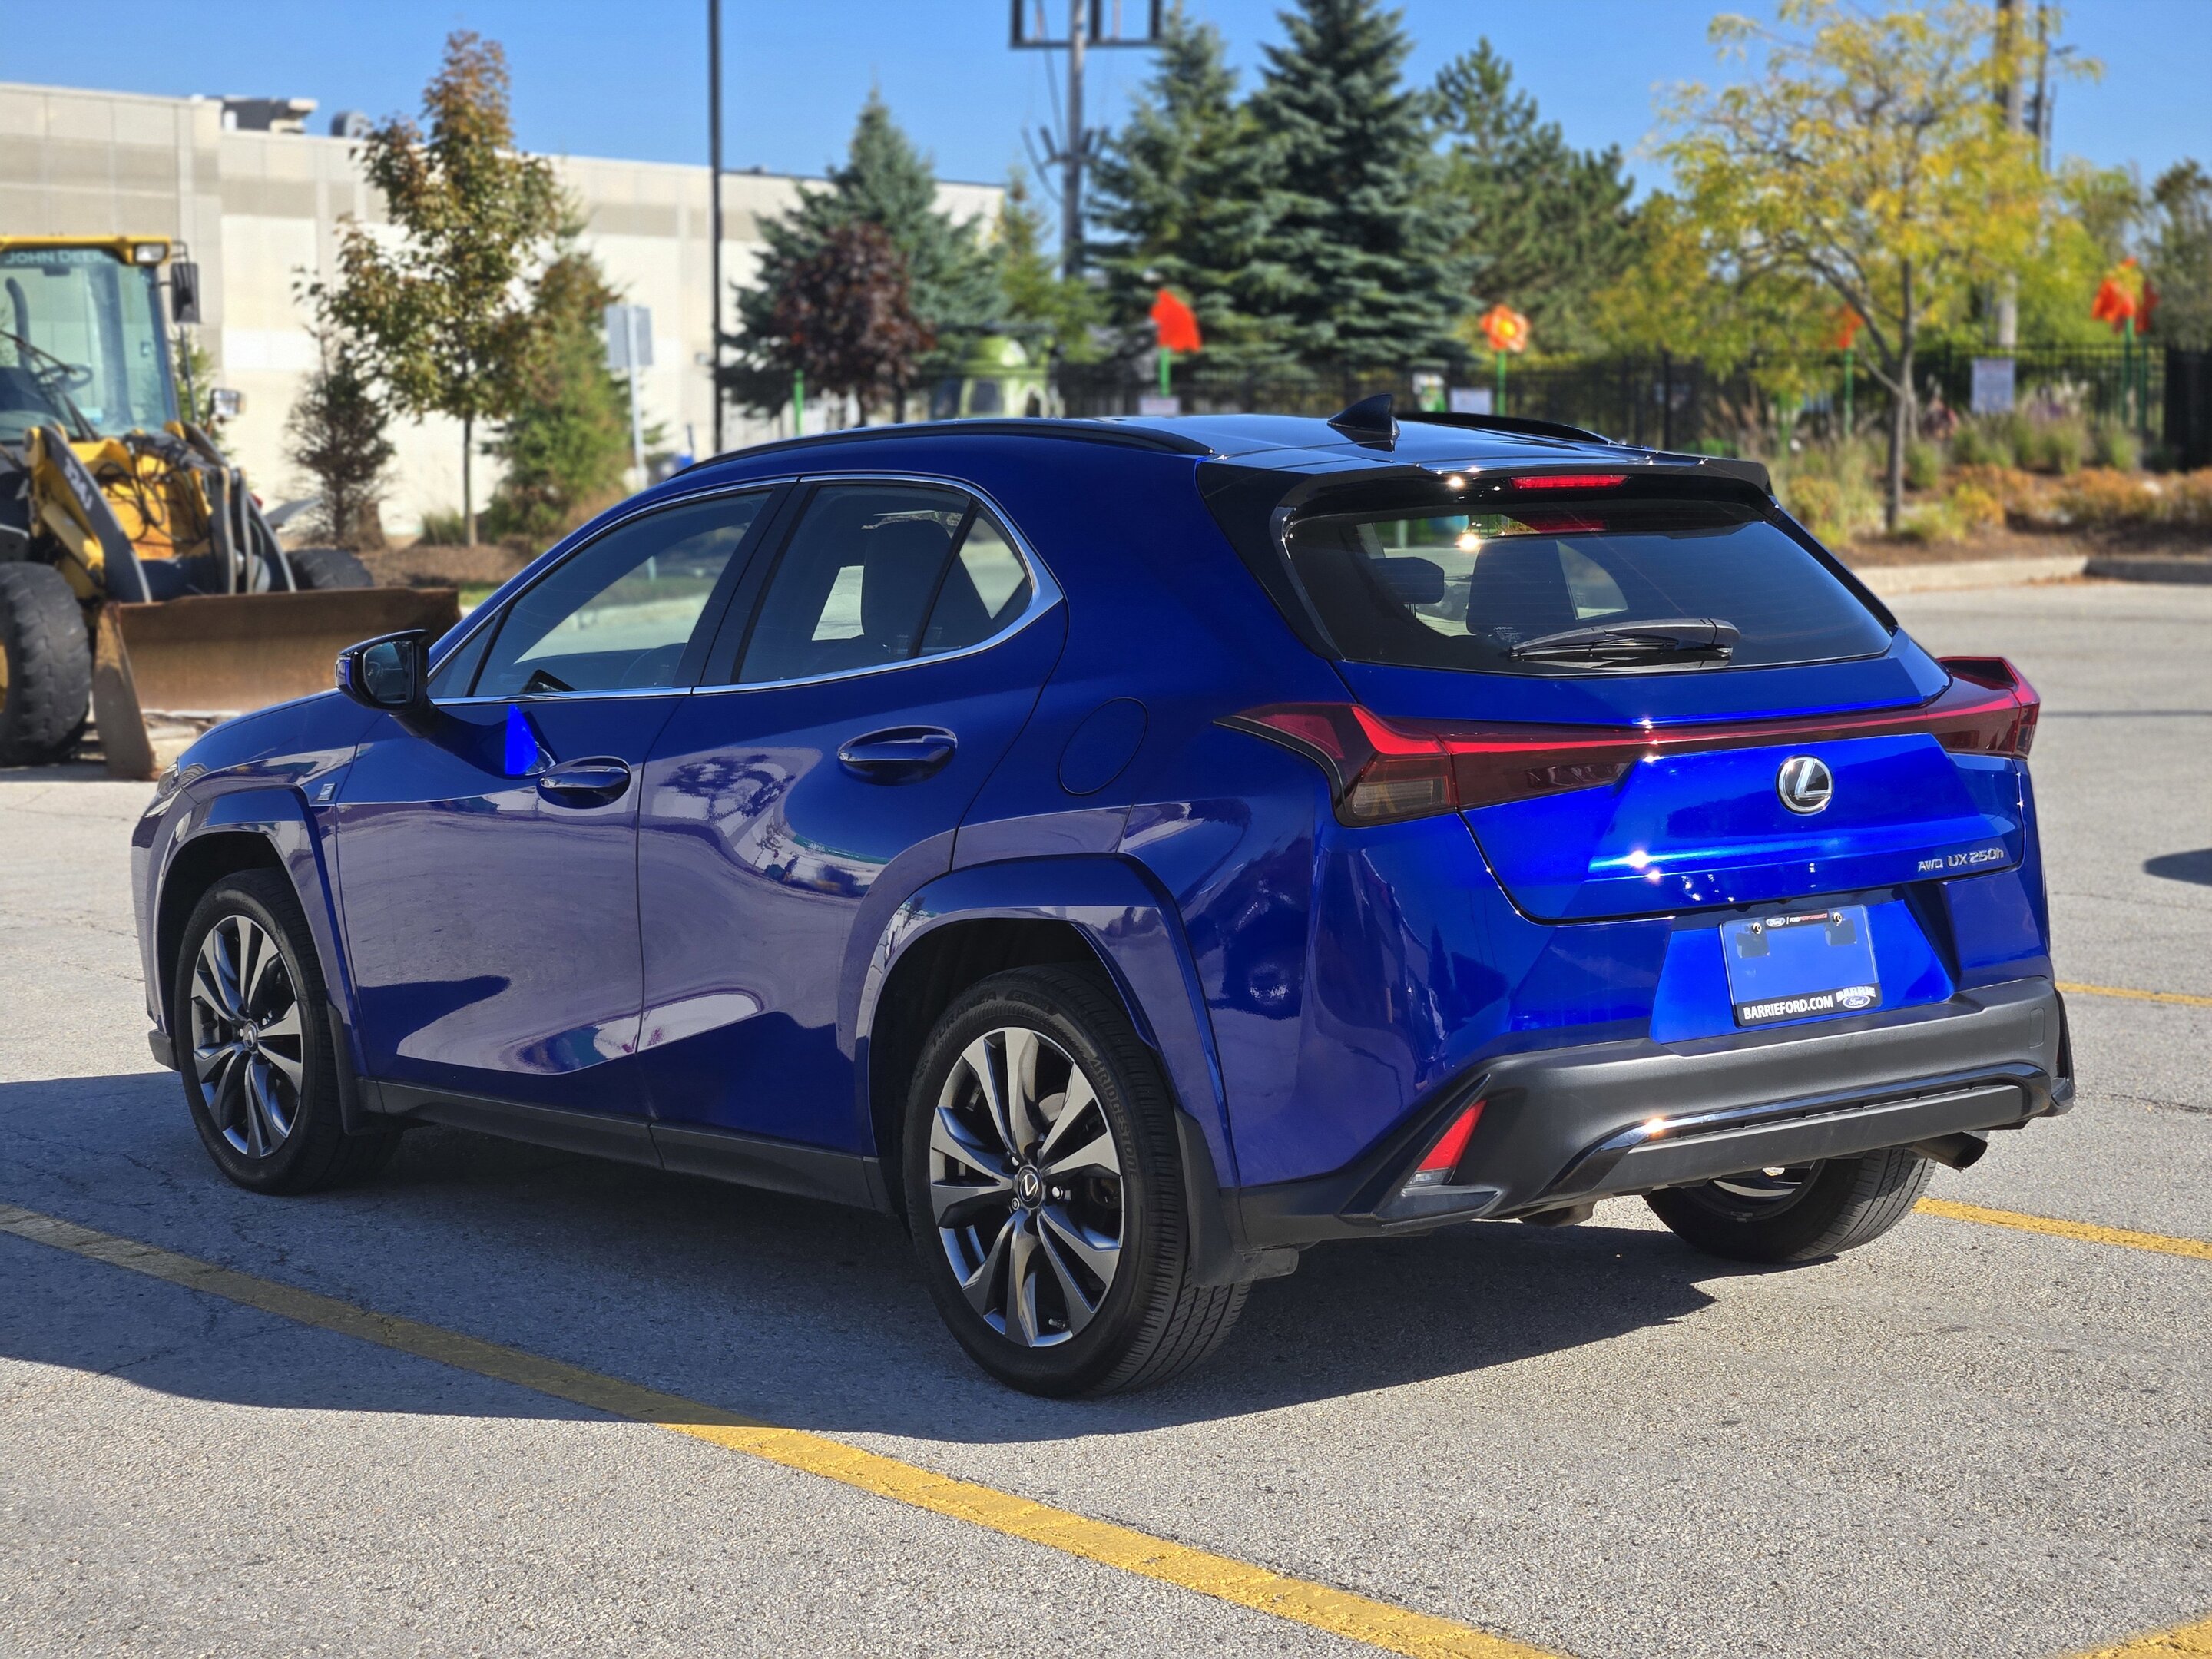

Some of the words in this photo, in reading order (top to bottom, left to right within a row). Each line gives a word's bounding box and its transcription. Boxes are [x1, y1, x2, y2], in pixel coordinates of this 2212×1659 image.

[5, 250, 55, 264] JOHN
[1918, 858, 1944, 872] AWD
[1947, 853, 1968, 867] UX
[1969, 847, 2004, 864] 250h
[1836, 985, 1876, 1002] BARRIE
[929, 991, 997, 1047] TURANZA
[1743, 995, 1834, 1020] BARRIEFORD.COM
[1089, 1055, 1139, 1182] BRIDGESTONE
